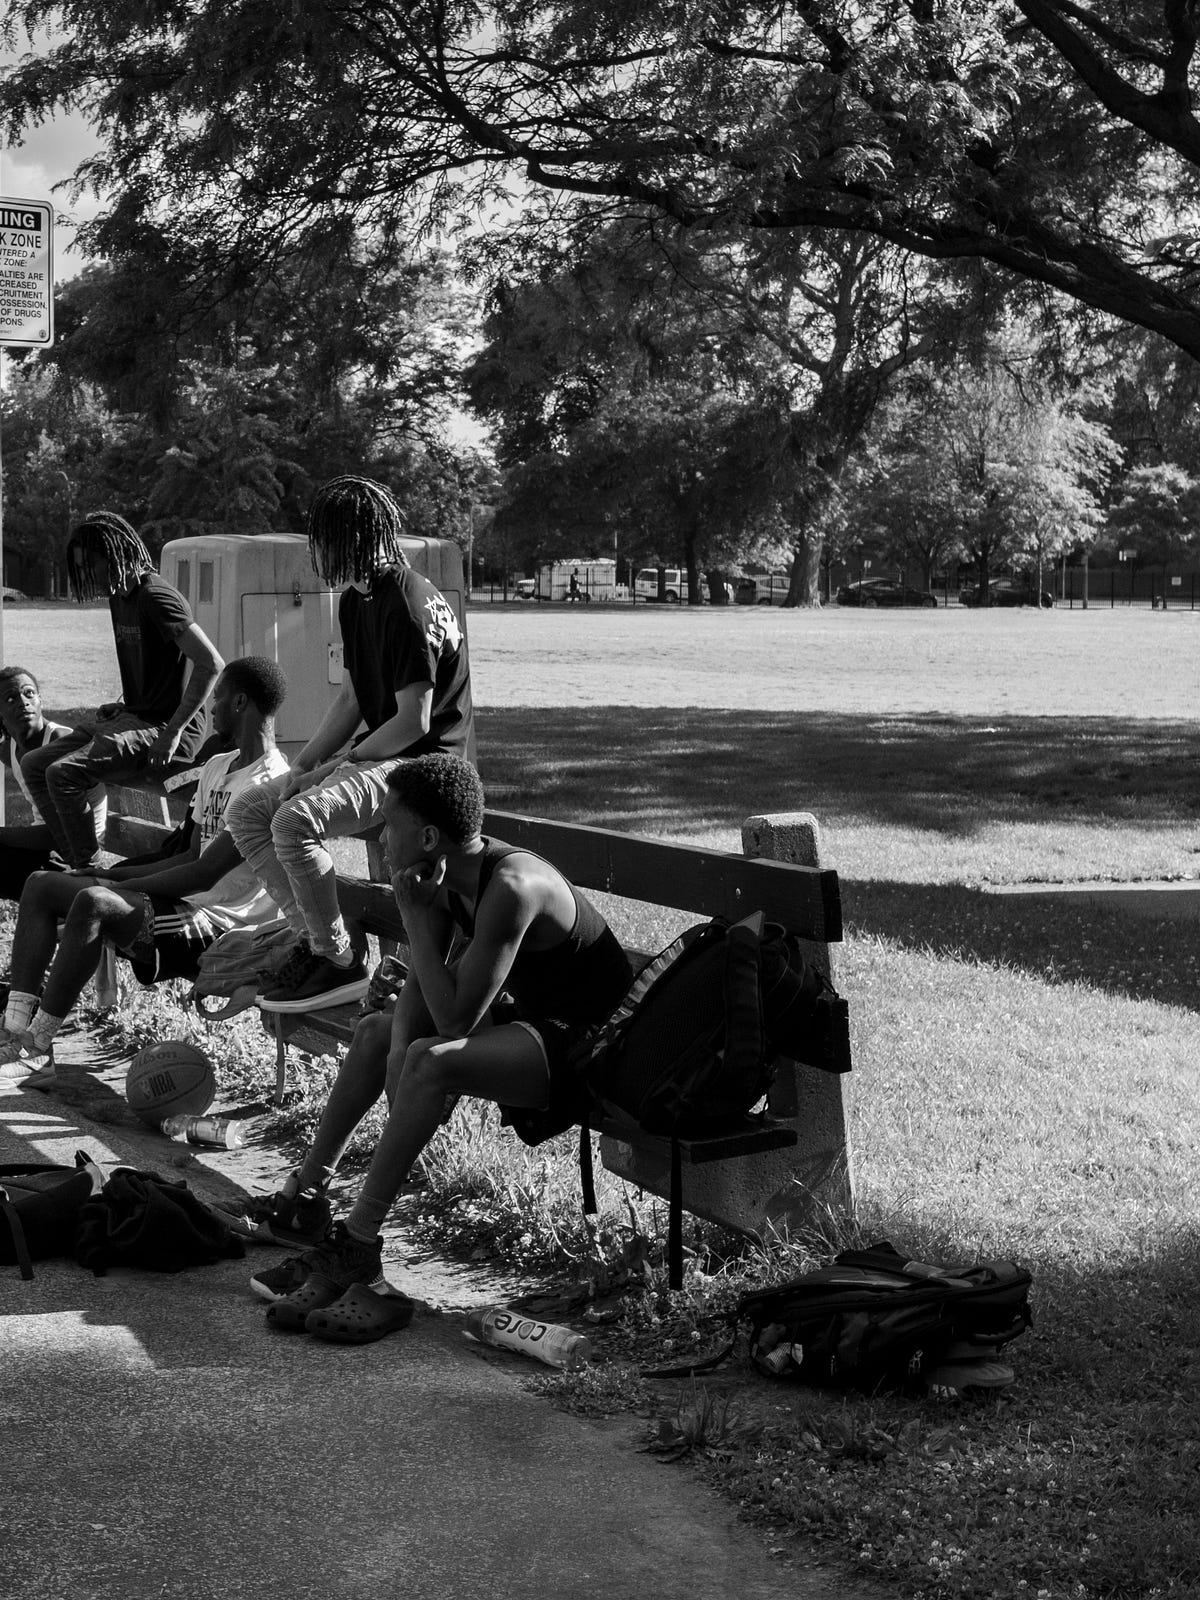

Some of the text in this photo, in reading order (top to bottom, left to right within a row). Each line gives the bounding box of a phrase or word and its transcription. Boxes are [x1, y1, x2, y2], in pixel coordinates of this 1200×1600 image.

[11, 233, 41, 249] ZONE
[28, 272, 44, 281] ARE
[1, 308, 12, 316] OF
[14, 309, 42, 318] DRUGS
[149, 1071, 177, 1097] NBA
[494, 1314, 547, 1341] core
